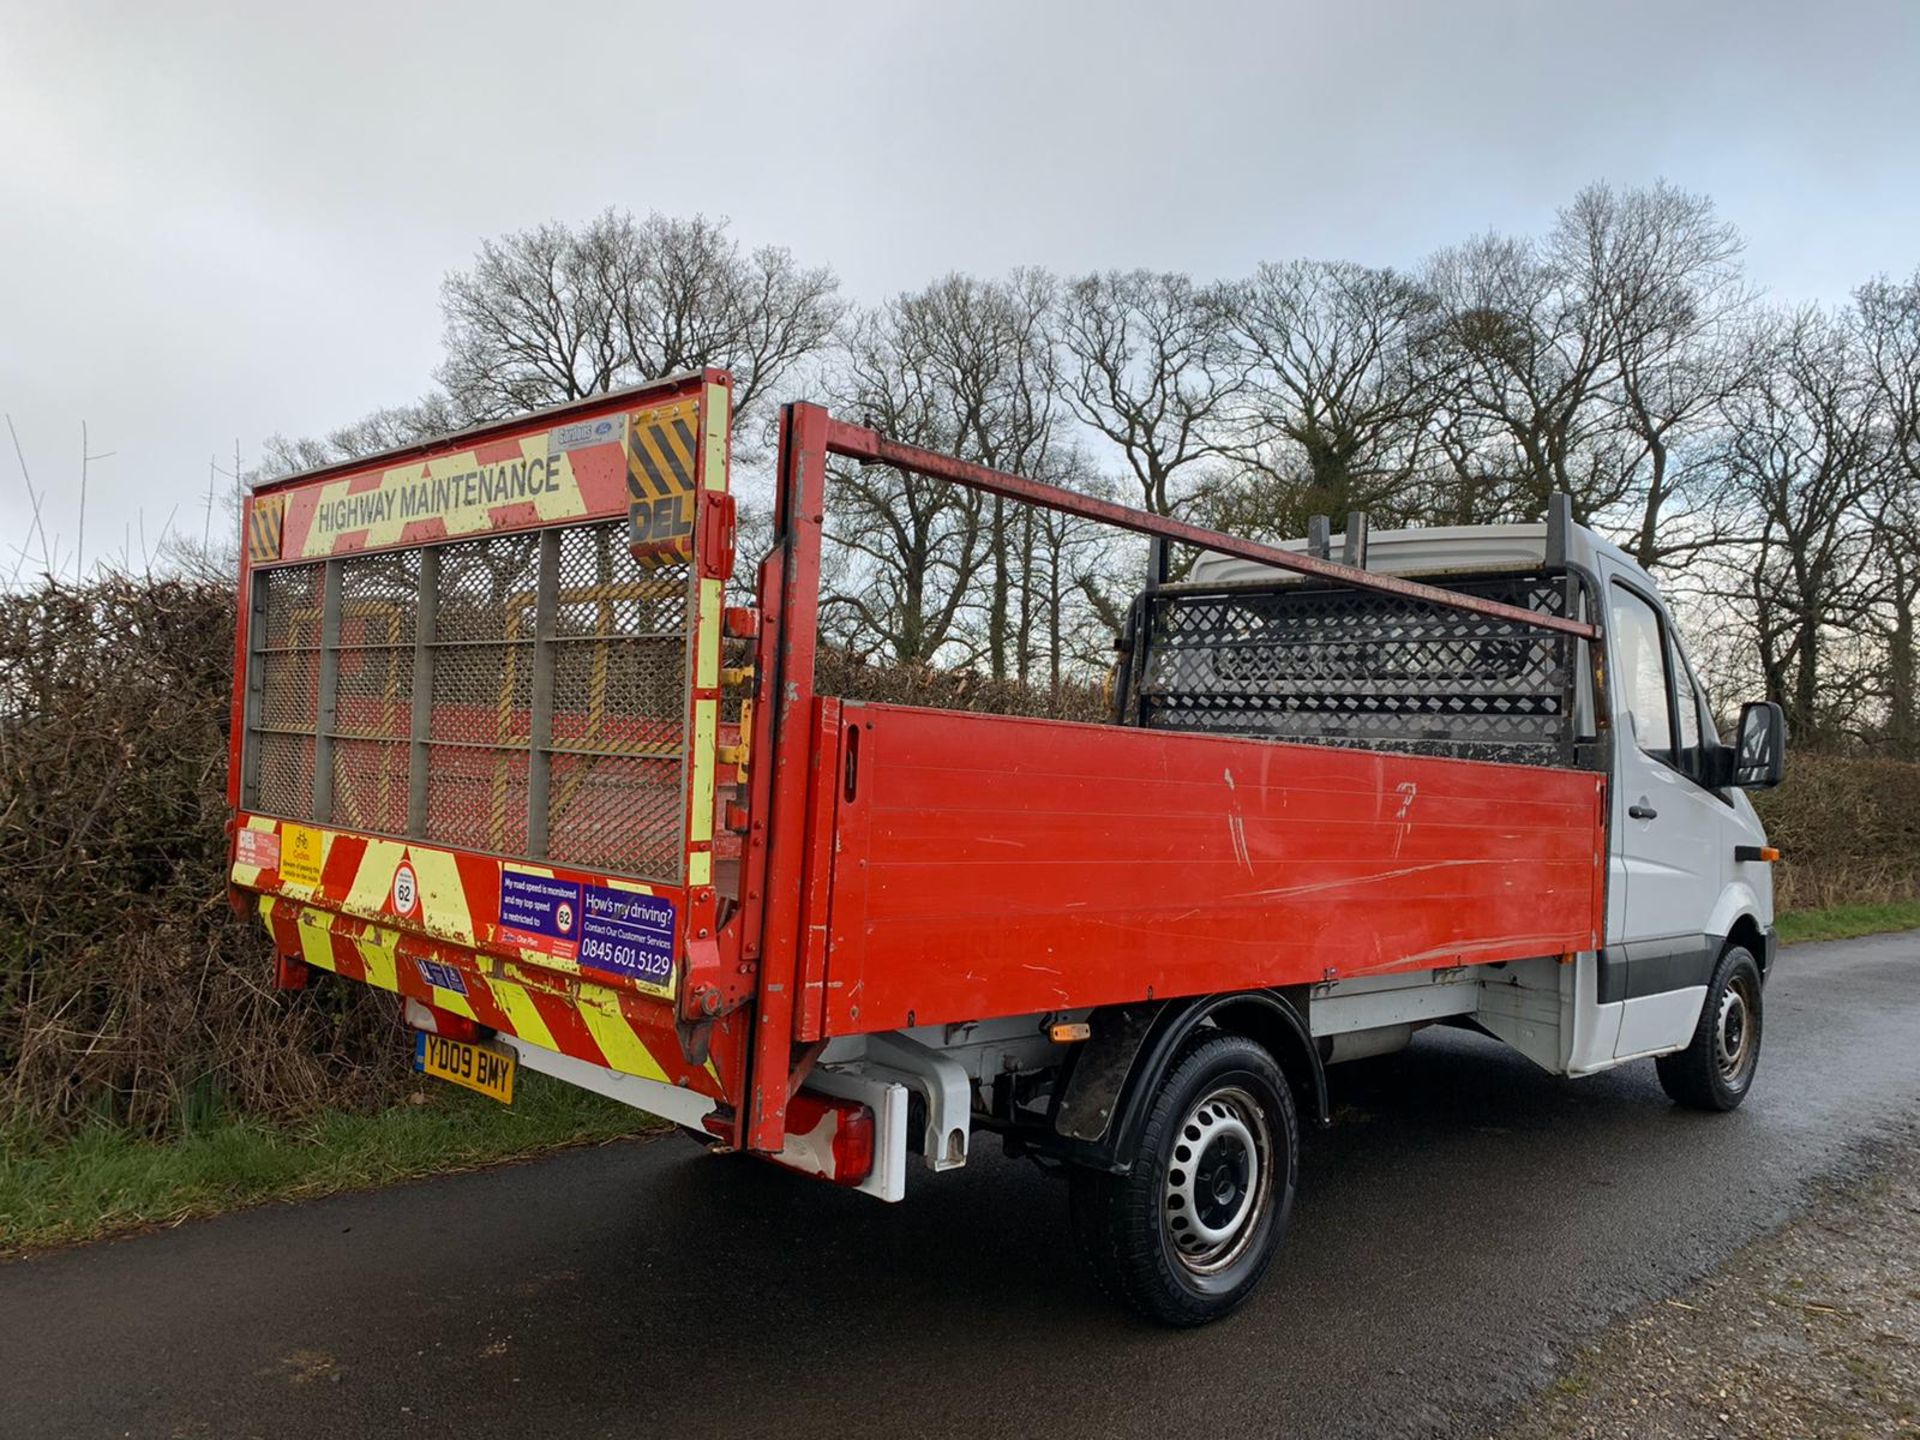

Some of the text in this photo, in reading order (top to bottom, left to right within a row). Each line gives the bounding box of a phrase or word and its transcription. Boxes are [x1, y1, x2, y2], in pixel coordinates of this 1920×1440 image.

[318, 455, 561, 533] HIGHWAY MAINTENANCE
[630, 494, 691, 543] DEL
[398, 885, 411, 902] 62
[505, 878, 577, 899] My road speed is monitored
[504, 895, 550, 912] and my top speed
[558, 910, 570, 925] 62
[585, 893, 673, 927] How's my driving?
[503, 910, 540, 927] is restricted to
[584, 921, 671, 949] Contact Our Customer Services
[582, 938, 613, 961] 0845
[614, 945, 636, 967] 601
[637, 951, 670, 976] 5129
[428, 1035, 509, 1093] YD09 BMY
